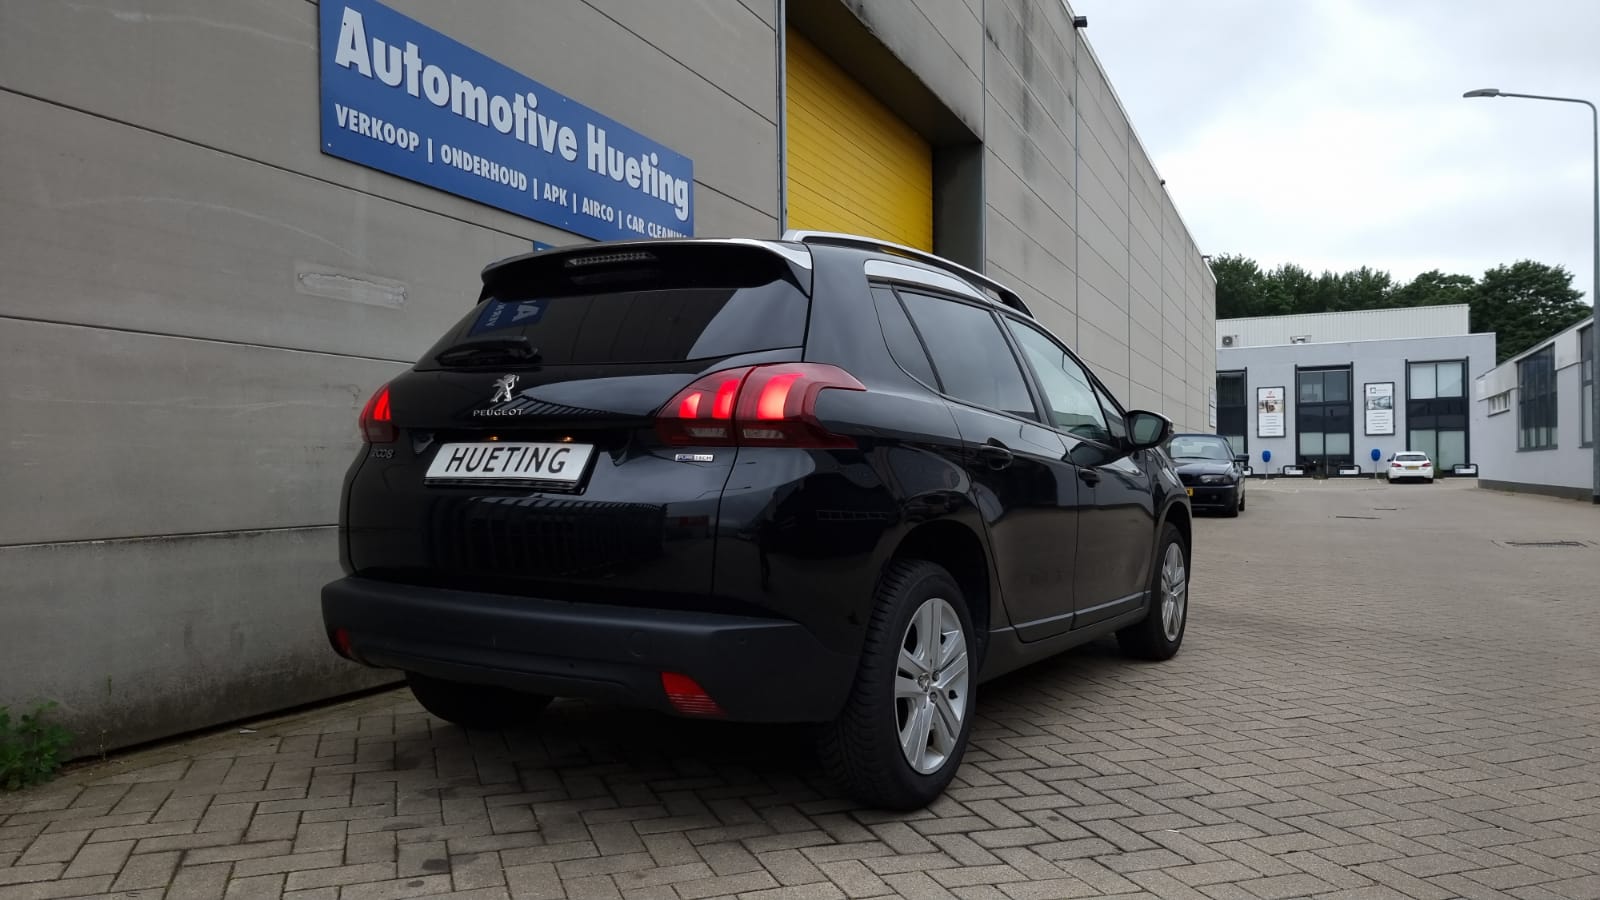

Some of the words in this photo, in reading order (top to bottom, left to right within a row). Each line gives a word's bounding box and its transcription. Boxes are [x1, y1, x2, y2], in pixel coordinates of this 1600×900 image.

[334, 6, 578, 162] Automotive
[587, 121, 689, 221] Hueting
[334, 103, 420, 153] VERKOOP
[440, 144, 528, 192] ONDERHOUD
[543, 182, 568, 207] APK
[582, 197, 614, 223] AIRCO
[626, 213, 645, 234] CAR
[647, 222, 687, 238] CLEANI
[473, 408, 524, 416] PEUGEOT
[445, 447, 571, 474] HUETING
